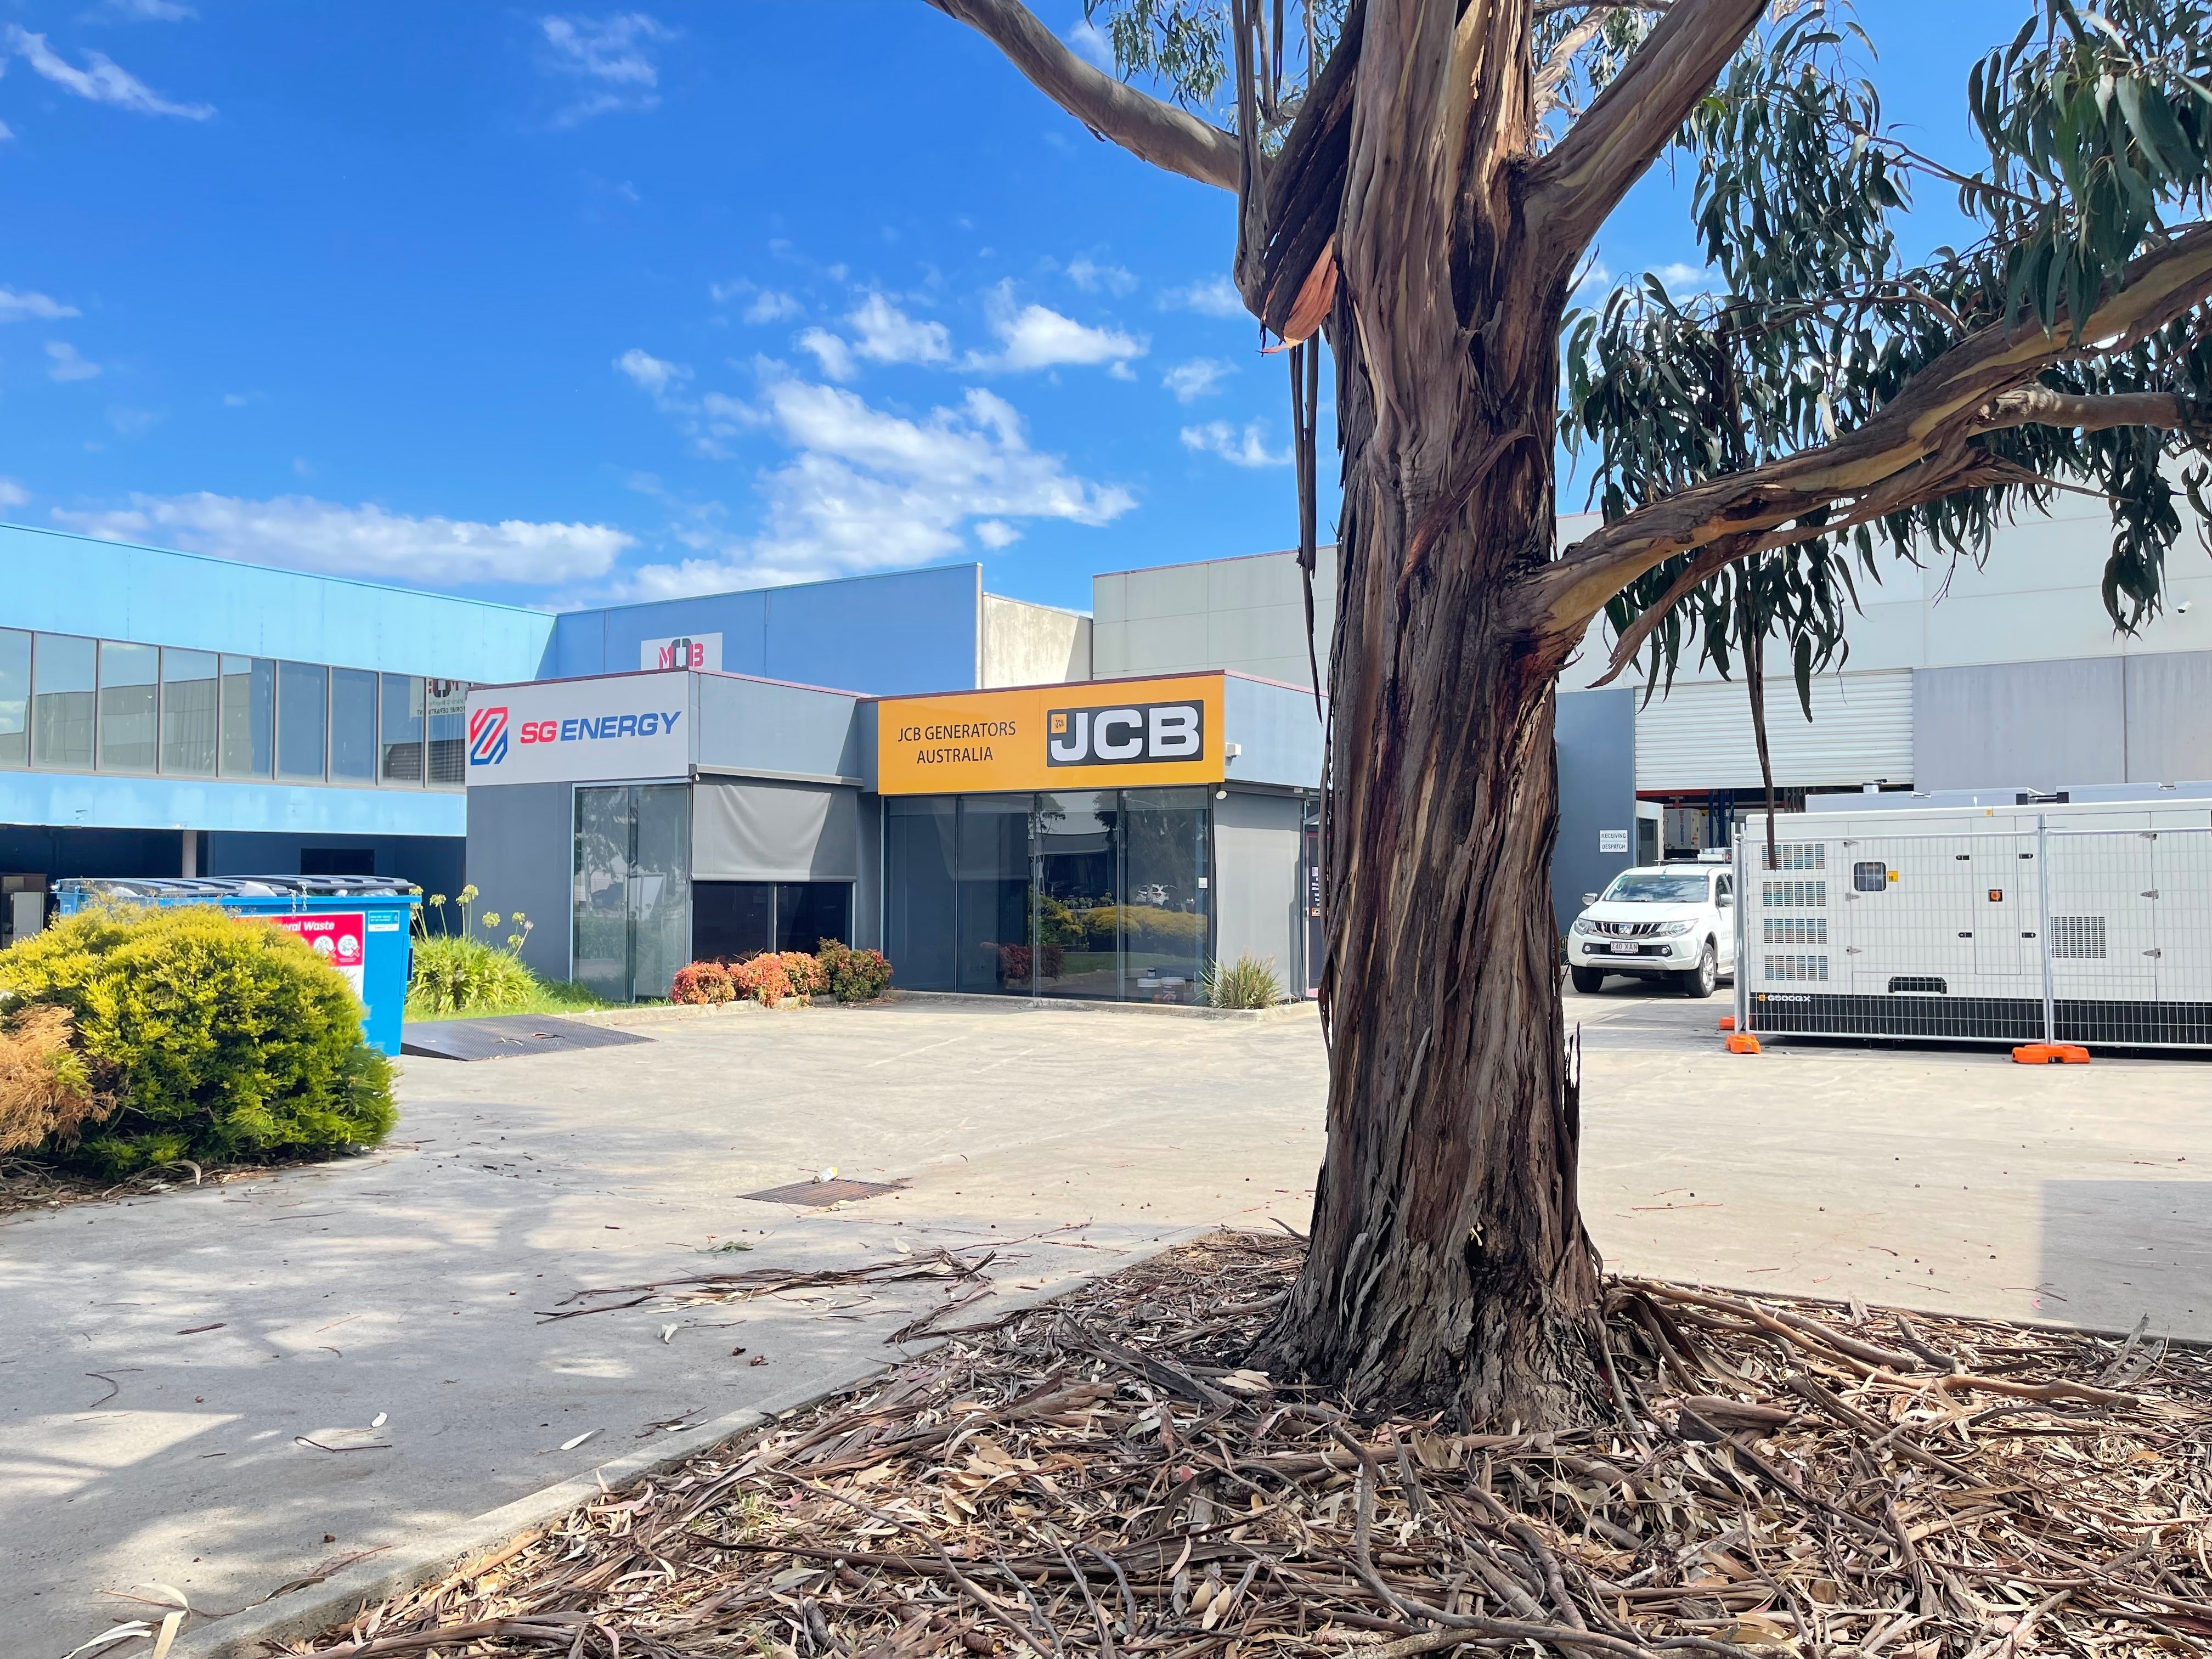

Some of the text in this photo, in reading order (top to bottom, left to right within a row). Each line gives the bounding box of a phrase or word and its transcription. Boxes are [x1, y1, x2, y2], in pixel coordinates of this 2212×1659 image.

[520, 711, 682, 744] SG ENERGY
[898, 721, 1016, 742] JCB GENERATORS
[1051, 706, 1200, 761] JCB
[917, 747, 993, 764] AUSTRALIA
[304, 921, 335, 931] Waste
